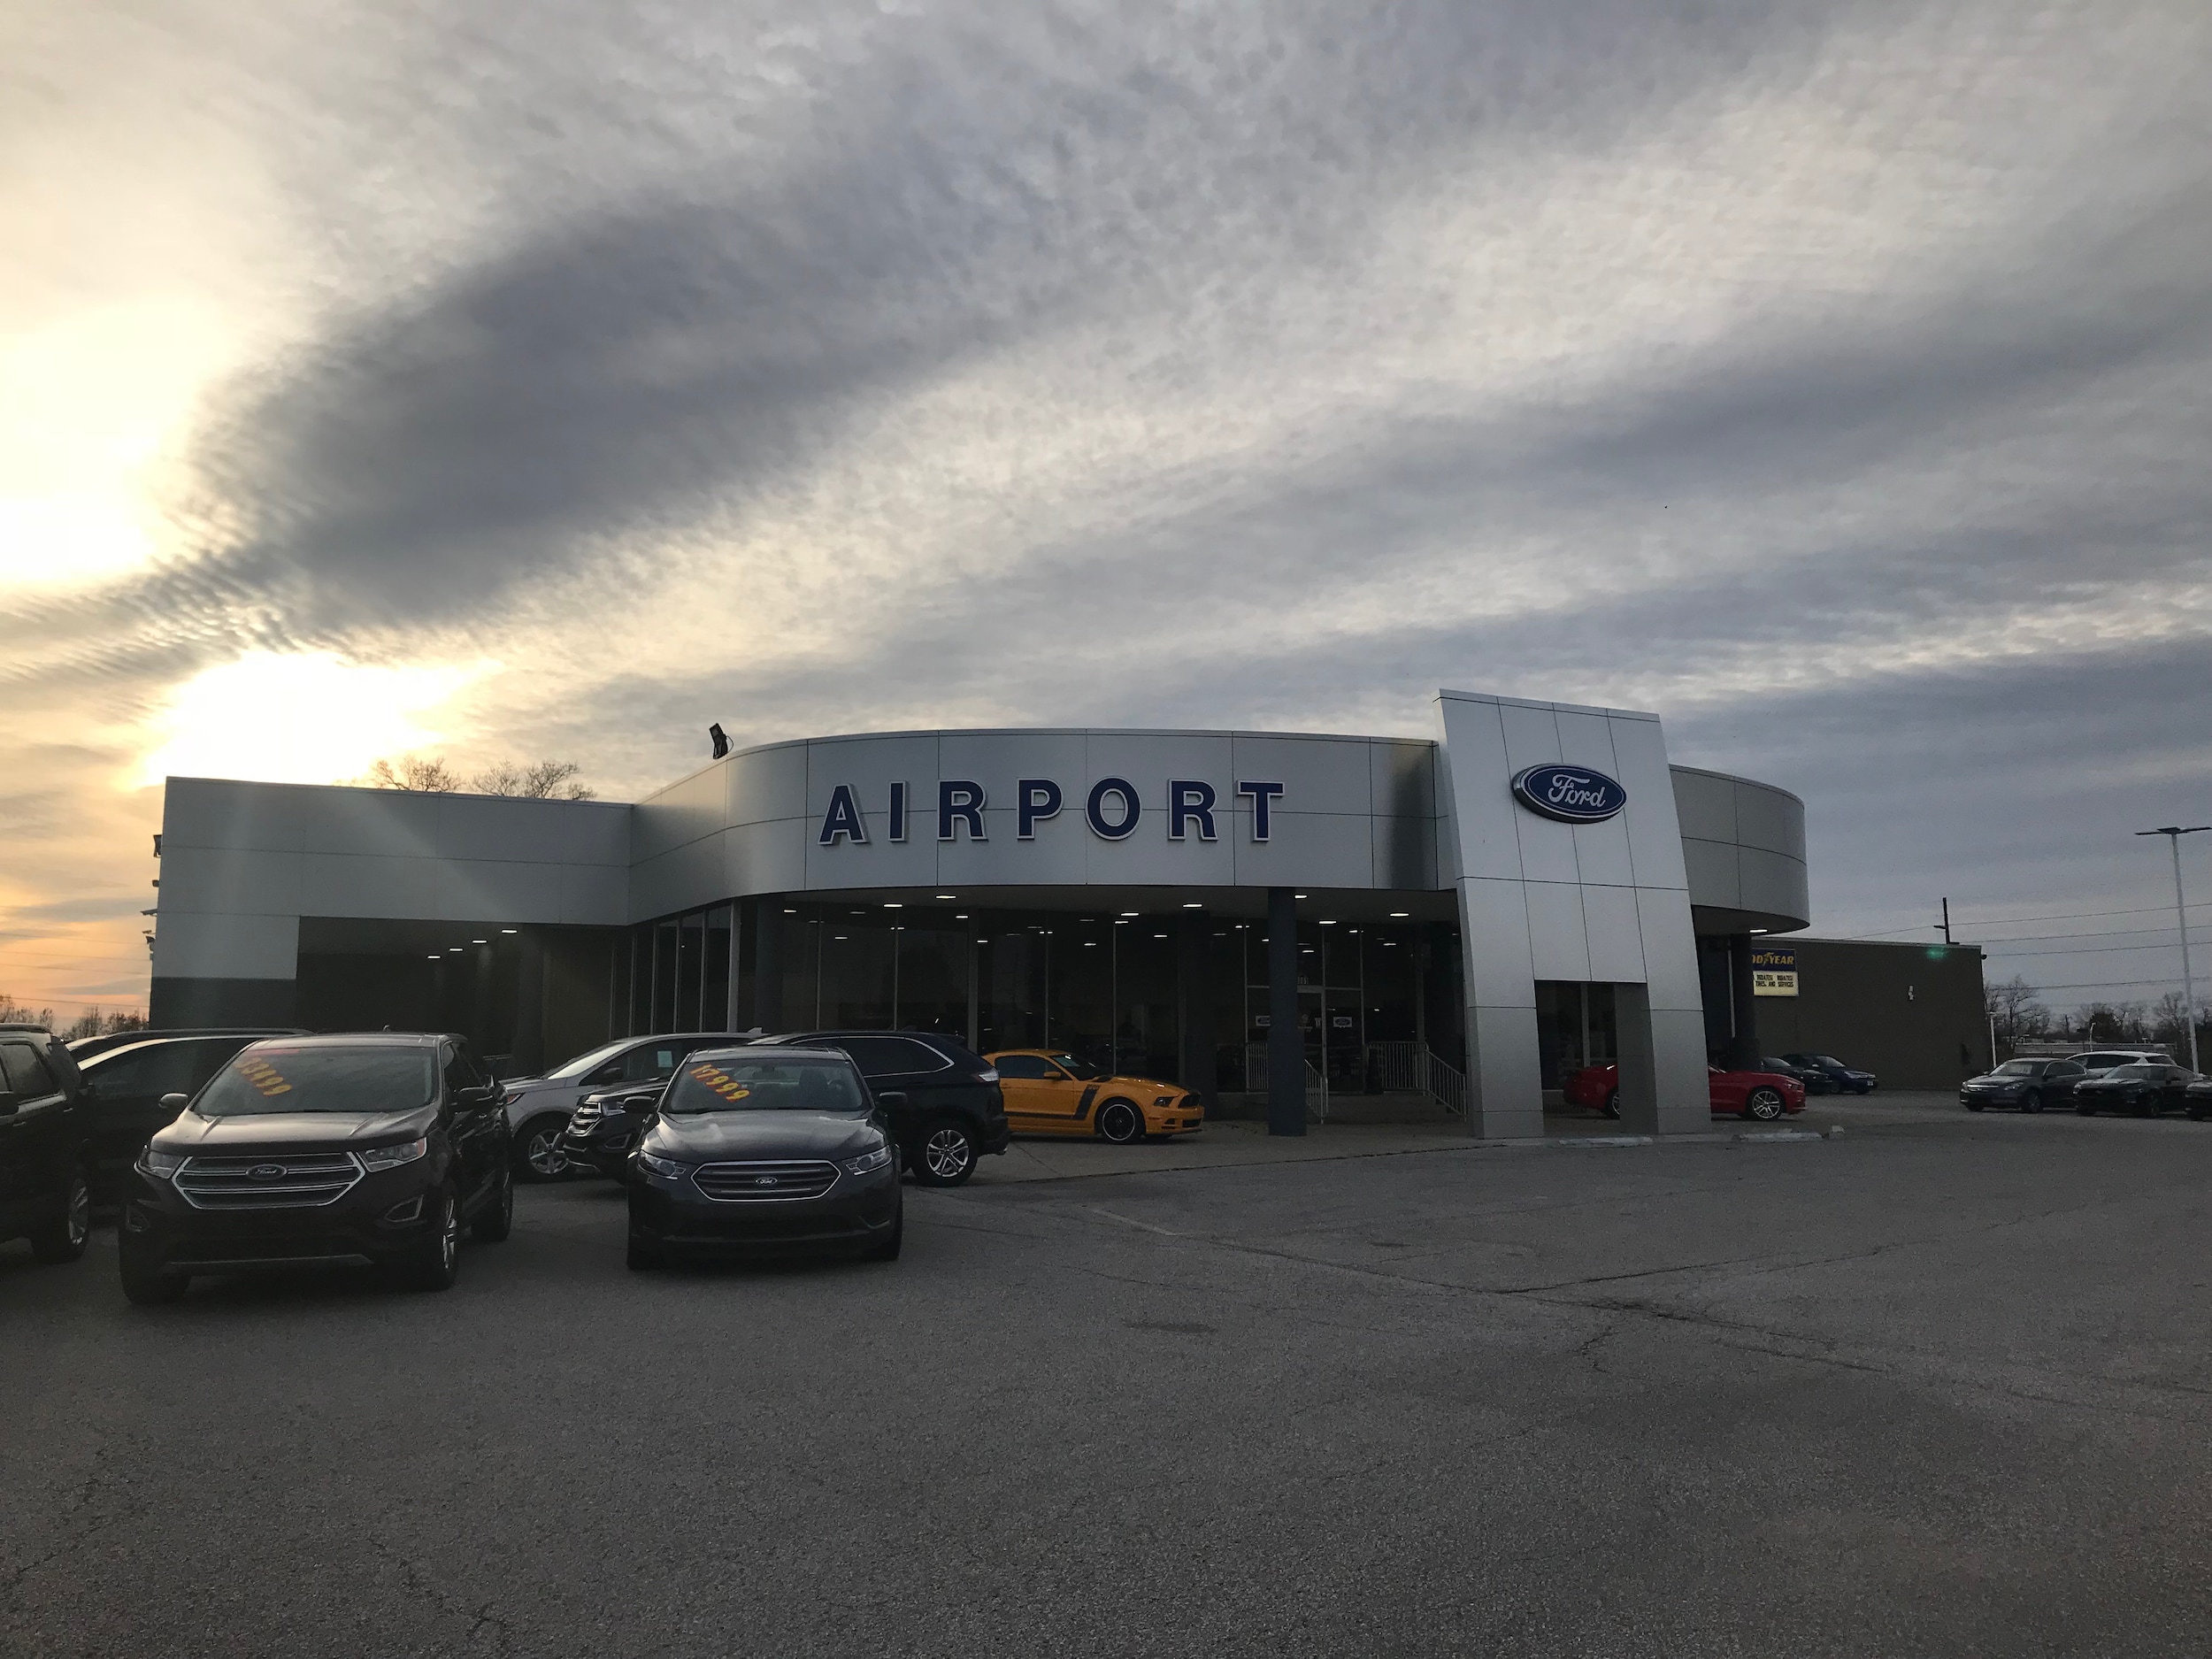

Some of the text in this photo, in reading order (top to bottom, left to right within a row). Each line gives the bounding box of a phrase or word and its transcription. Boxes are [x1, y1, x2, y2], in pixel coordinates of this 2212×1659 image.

[1548, 773, 1606, 808] Ford
[818, 776, 1285, 845] AIRPORT
[689, 1064, 751, 1102] 17999
